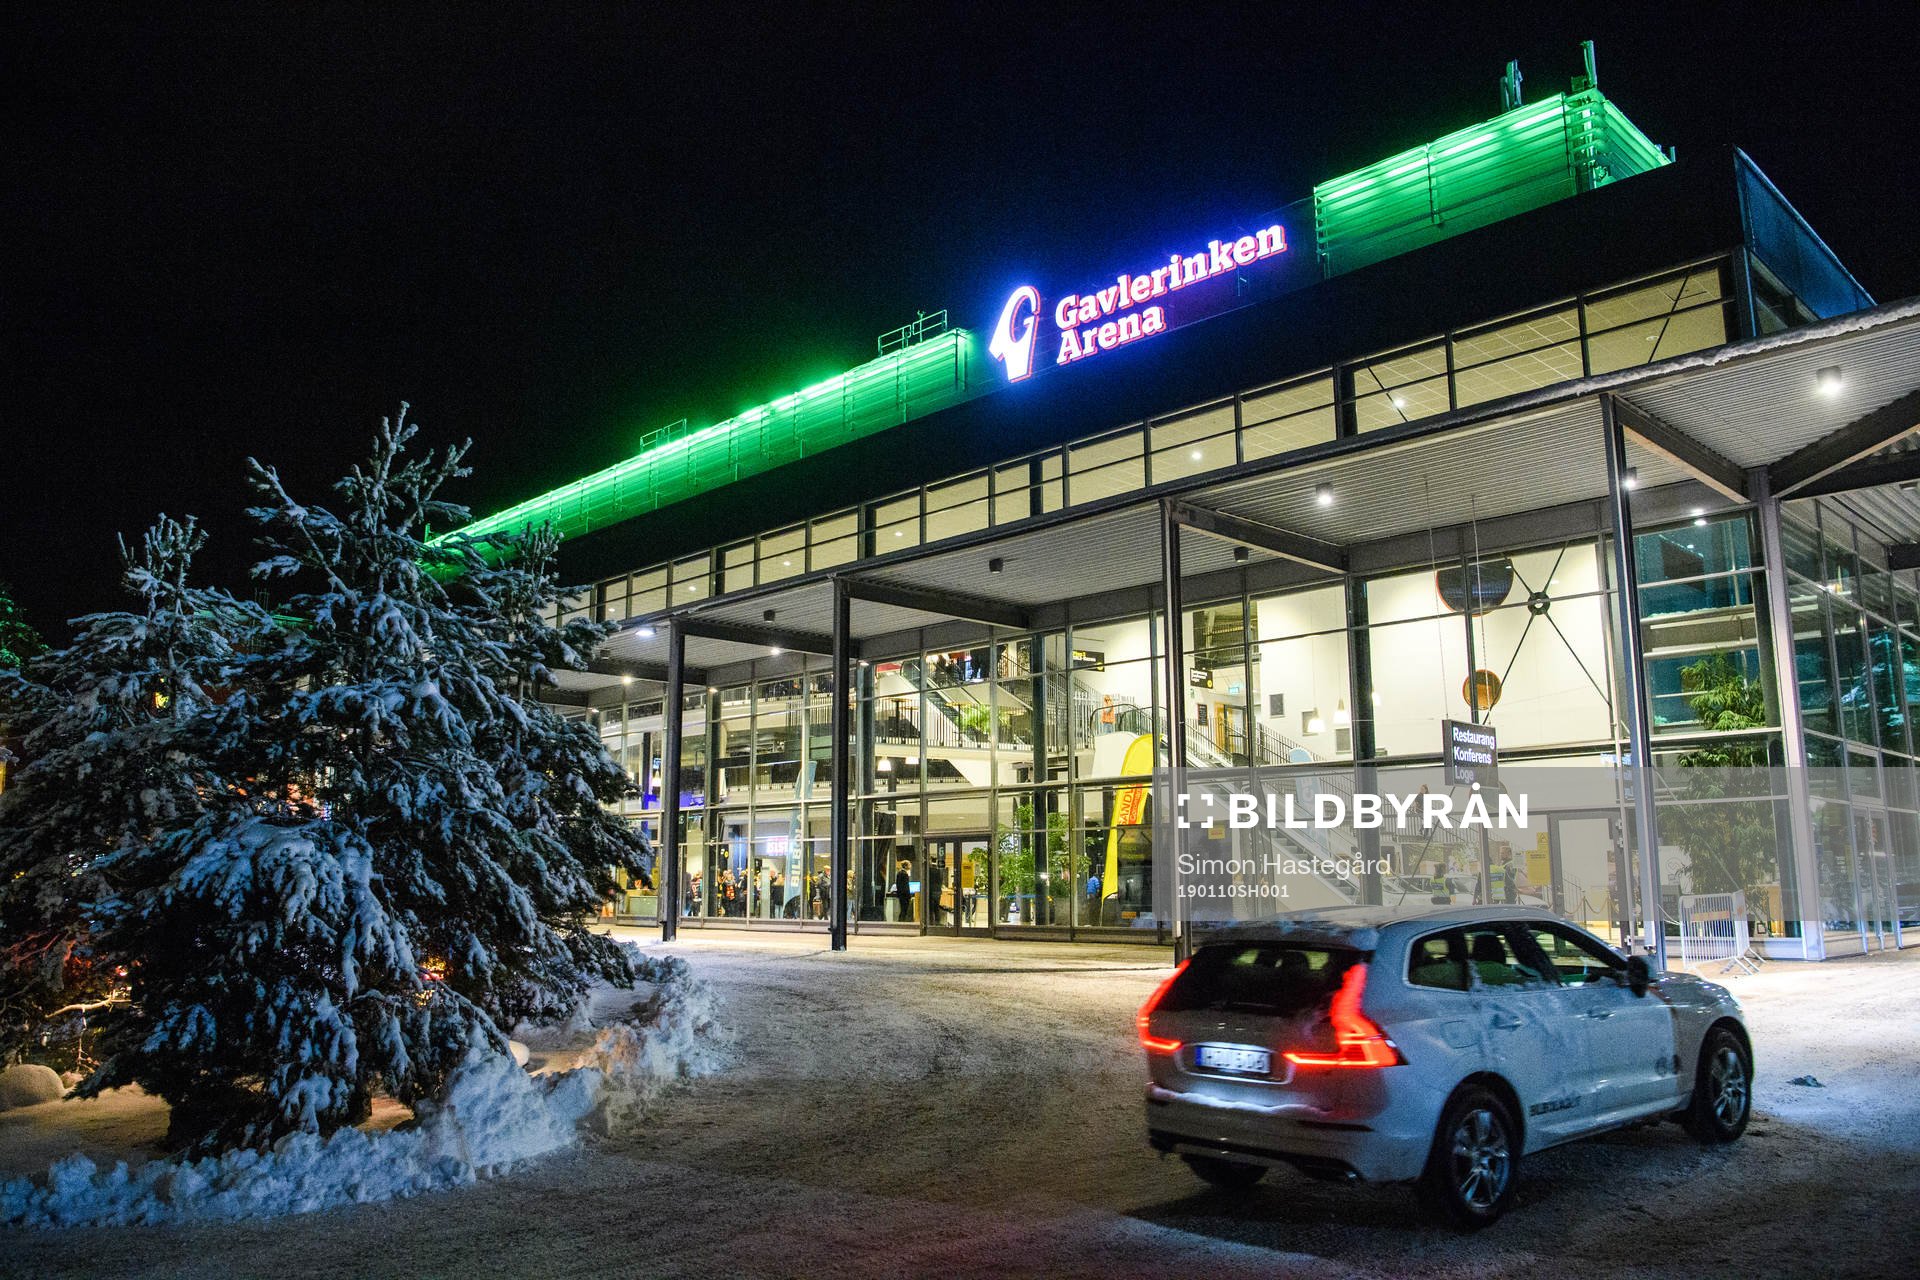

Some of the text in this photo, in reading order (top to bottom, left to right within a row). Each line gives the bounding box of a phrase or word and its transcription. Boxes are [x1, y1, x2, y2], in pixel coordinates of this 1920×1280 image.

[1055, 224, 1287, 330] Gavlerinken
[1057, 306, 1166, 365] Arena
[1453, 727, 1496, 750] Restaurang
[1454, 746, 1492, 765] Konferens
[1455, 765, 1475, 783] Loge
